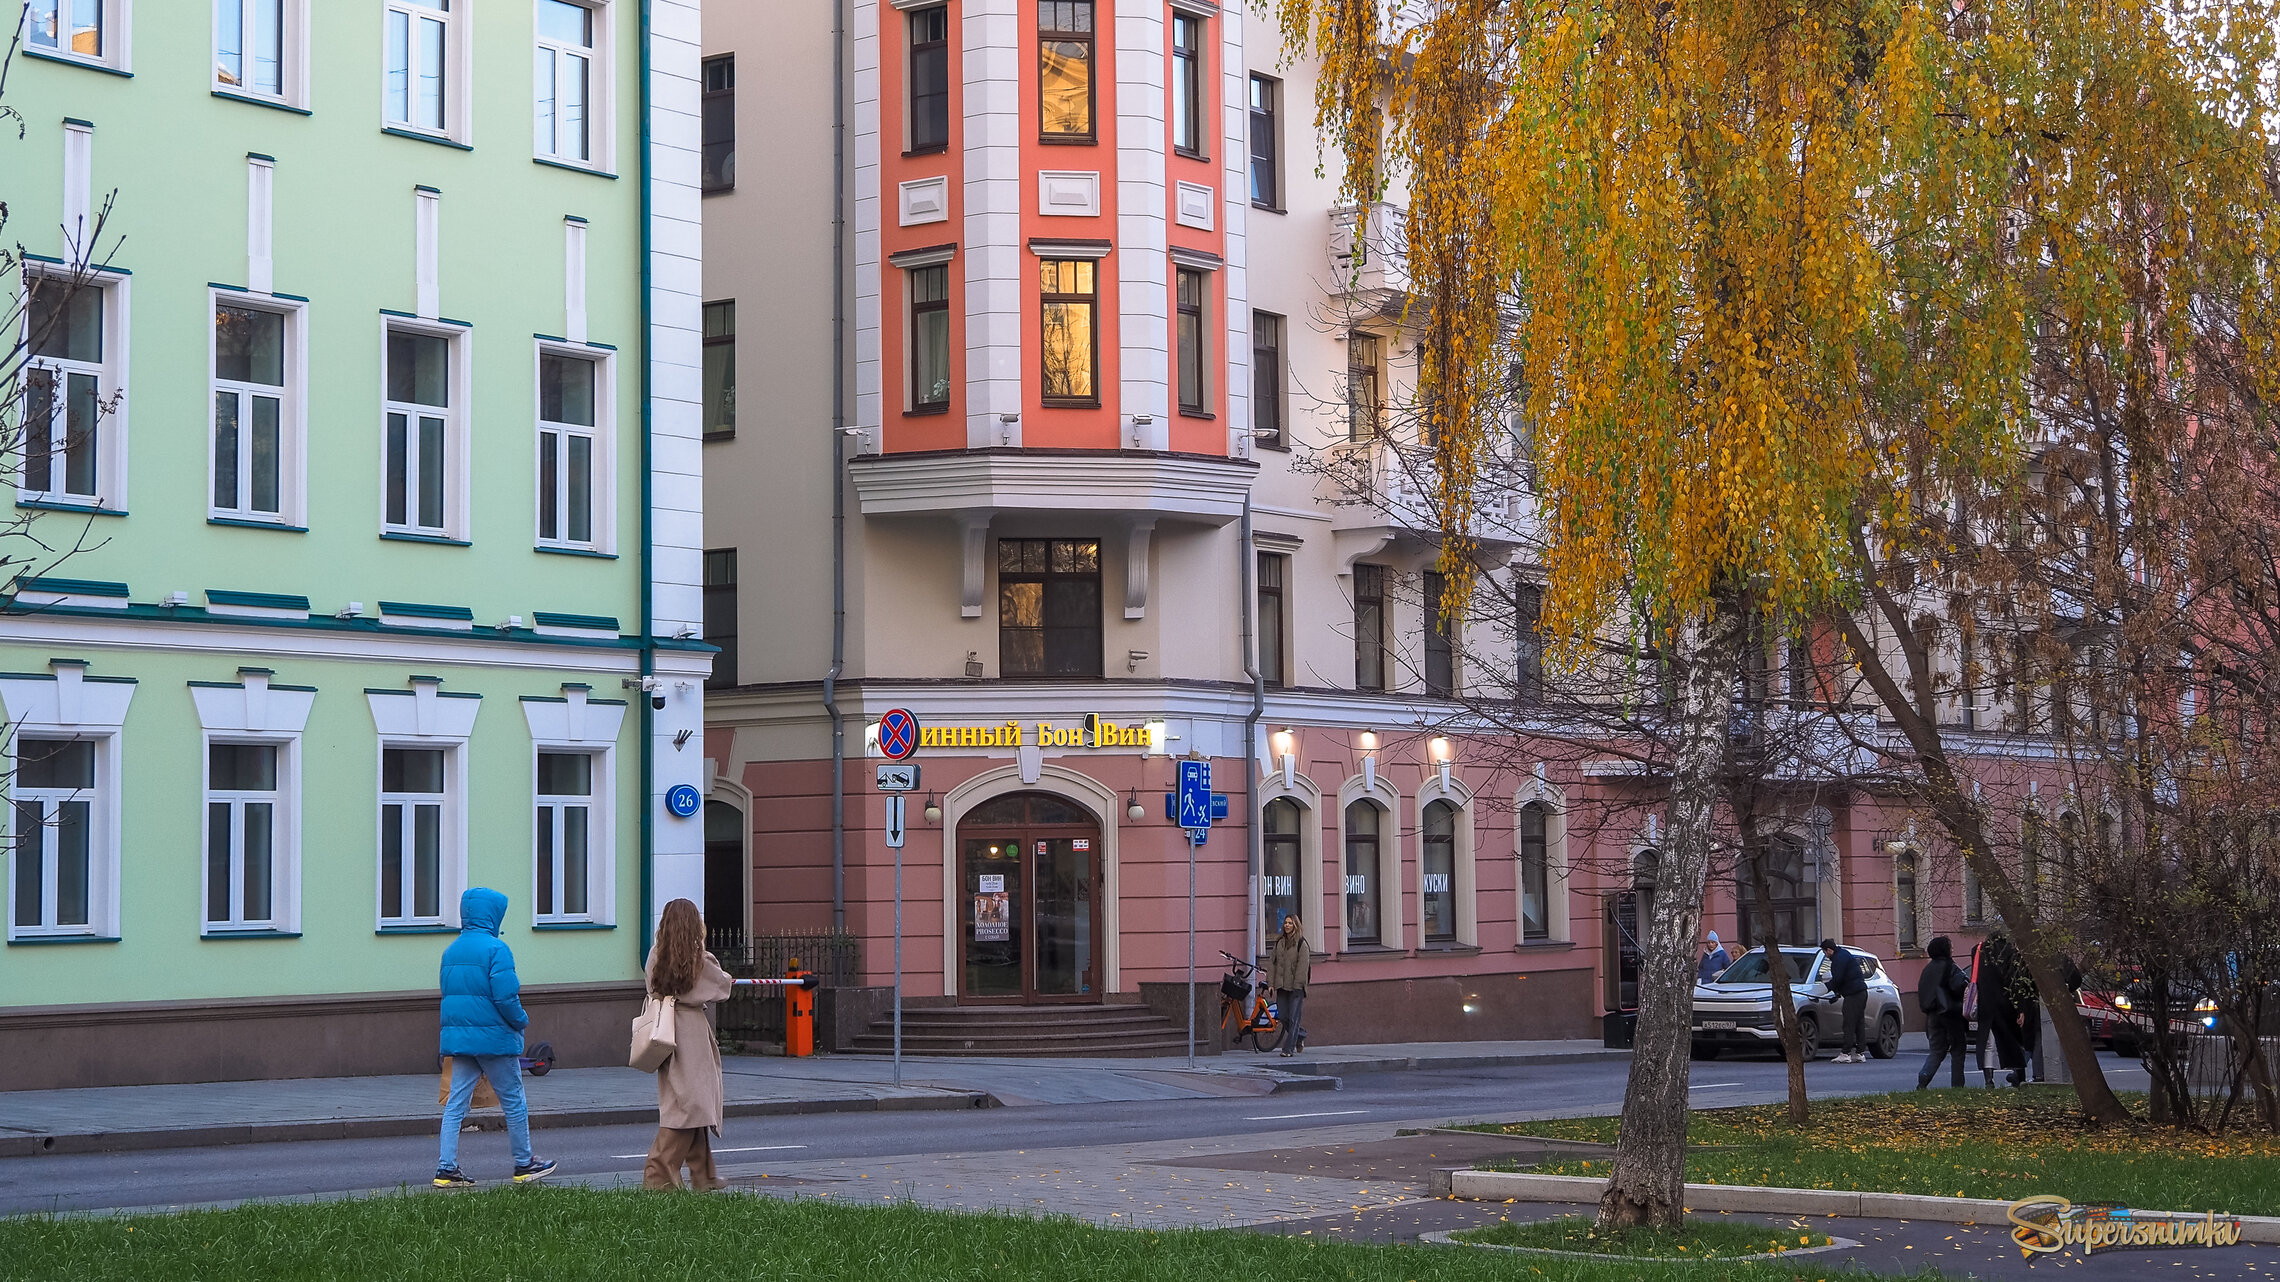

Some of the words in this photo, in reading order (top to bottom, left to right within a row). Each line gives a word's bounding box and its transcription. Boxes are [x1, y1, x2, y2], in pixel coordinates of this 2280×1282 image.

[920, 720, 1023, 747] инный
[1036, 722, 1084, 747] Бон
[1101, 722, 1153, 747] Вин
[678, 794, 694, 808] 26
[1195, 828, 1206, 839] 24
[1275, 875, 1292, 896] ВИН
[1345, 874, 1365, 894] ВИНО
[1423, 873, 1448, 893] КУСКИ
